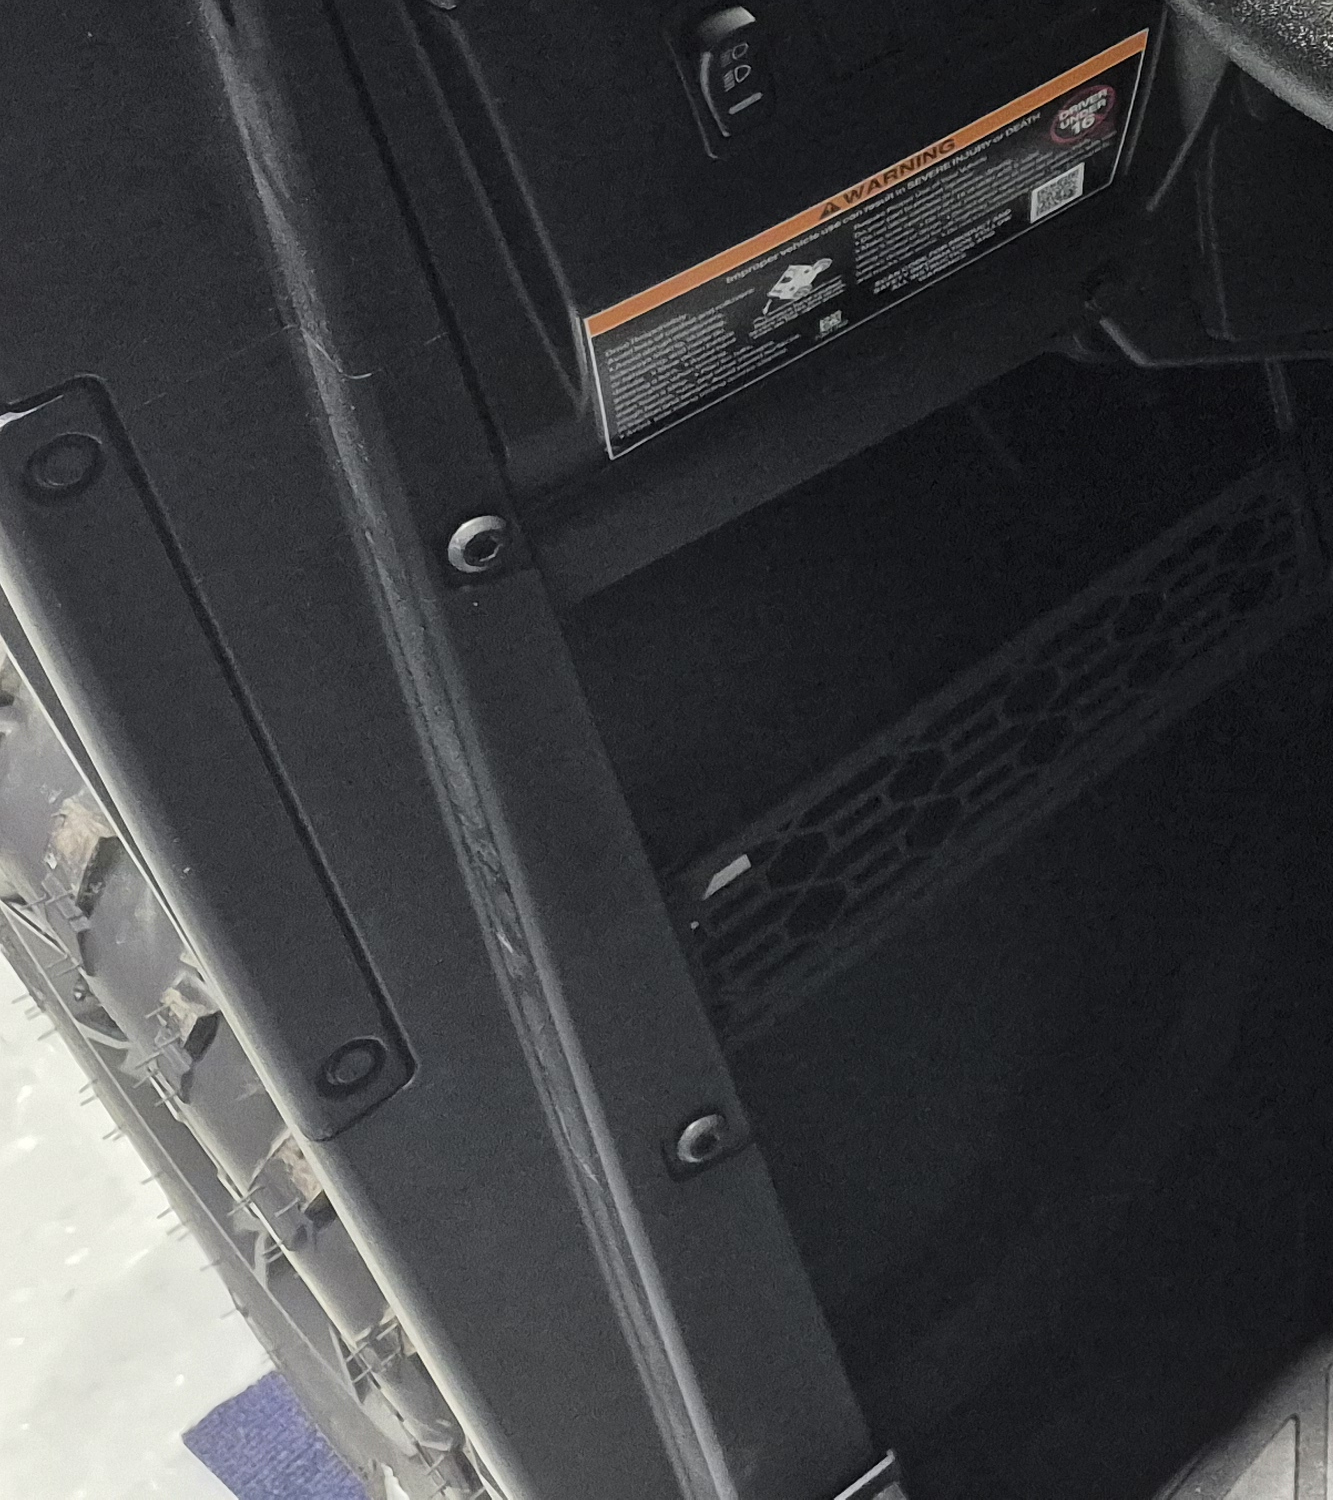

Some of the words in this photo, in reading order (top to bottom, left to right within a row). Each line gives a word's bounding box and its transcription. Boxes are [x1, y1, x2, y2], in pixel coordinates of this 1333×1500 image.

[1059, 88, 1108, 121] DRIVER
[1059, 98, 1107, 130] UNDER
[1070, 113, 1096, 136] 16
[843, 137, 956, 205] WARNING
[725, 253, 778, 284] Improper
[780, 231, 819, 257] vehicle
[821, 222, 840, 236] use
[842, 211, 862, 224] can
[864, 192, 894, 213] result
[907, 161, 951, 191] SEVERE
[952, 139, 991, 167] INJURY
[1004, 113, 1041, 138] DEATH
